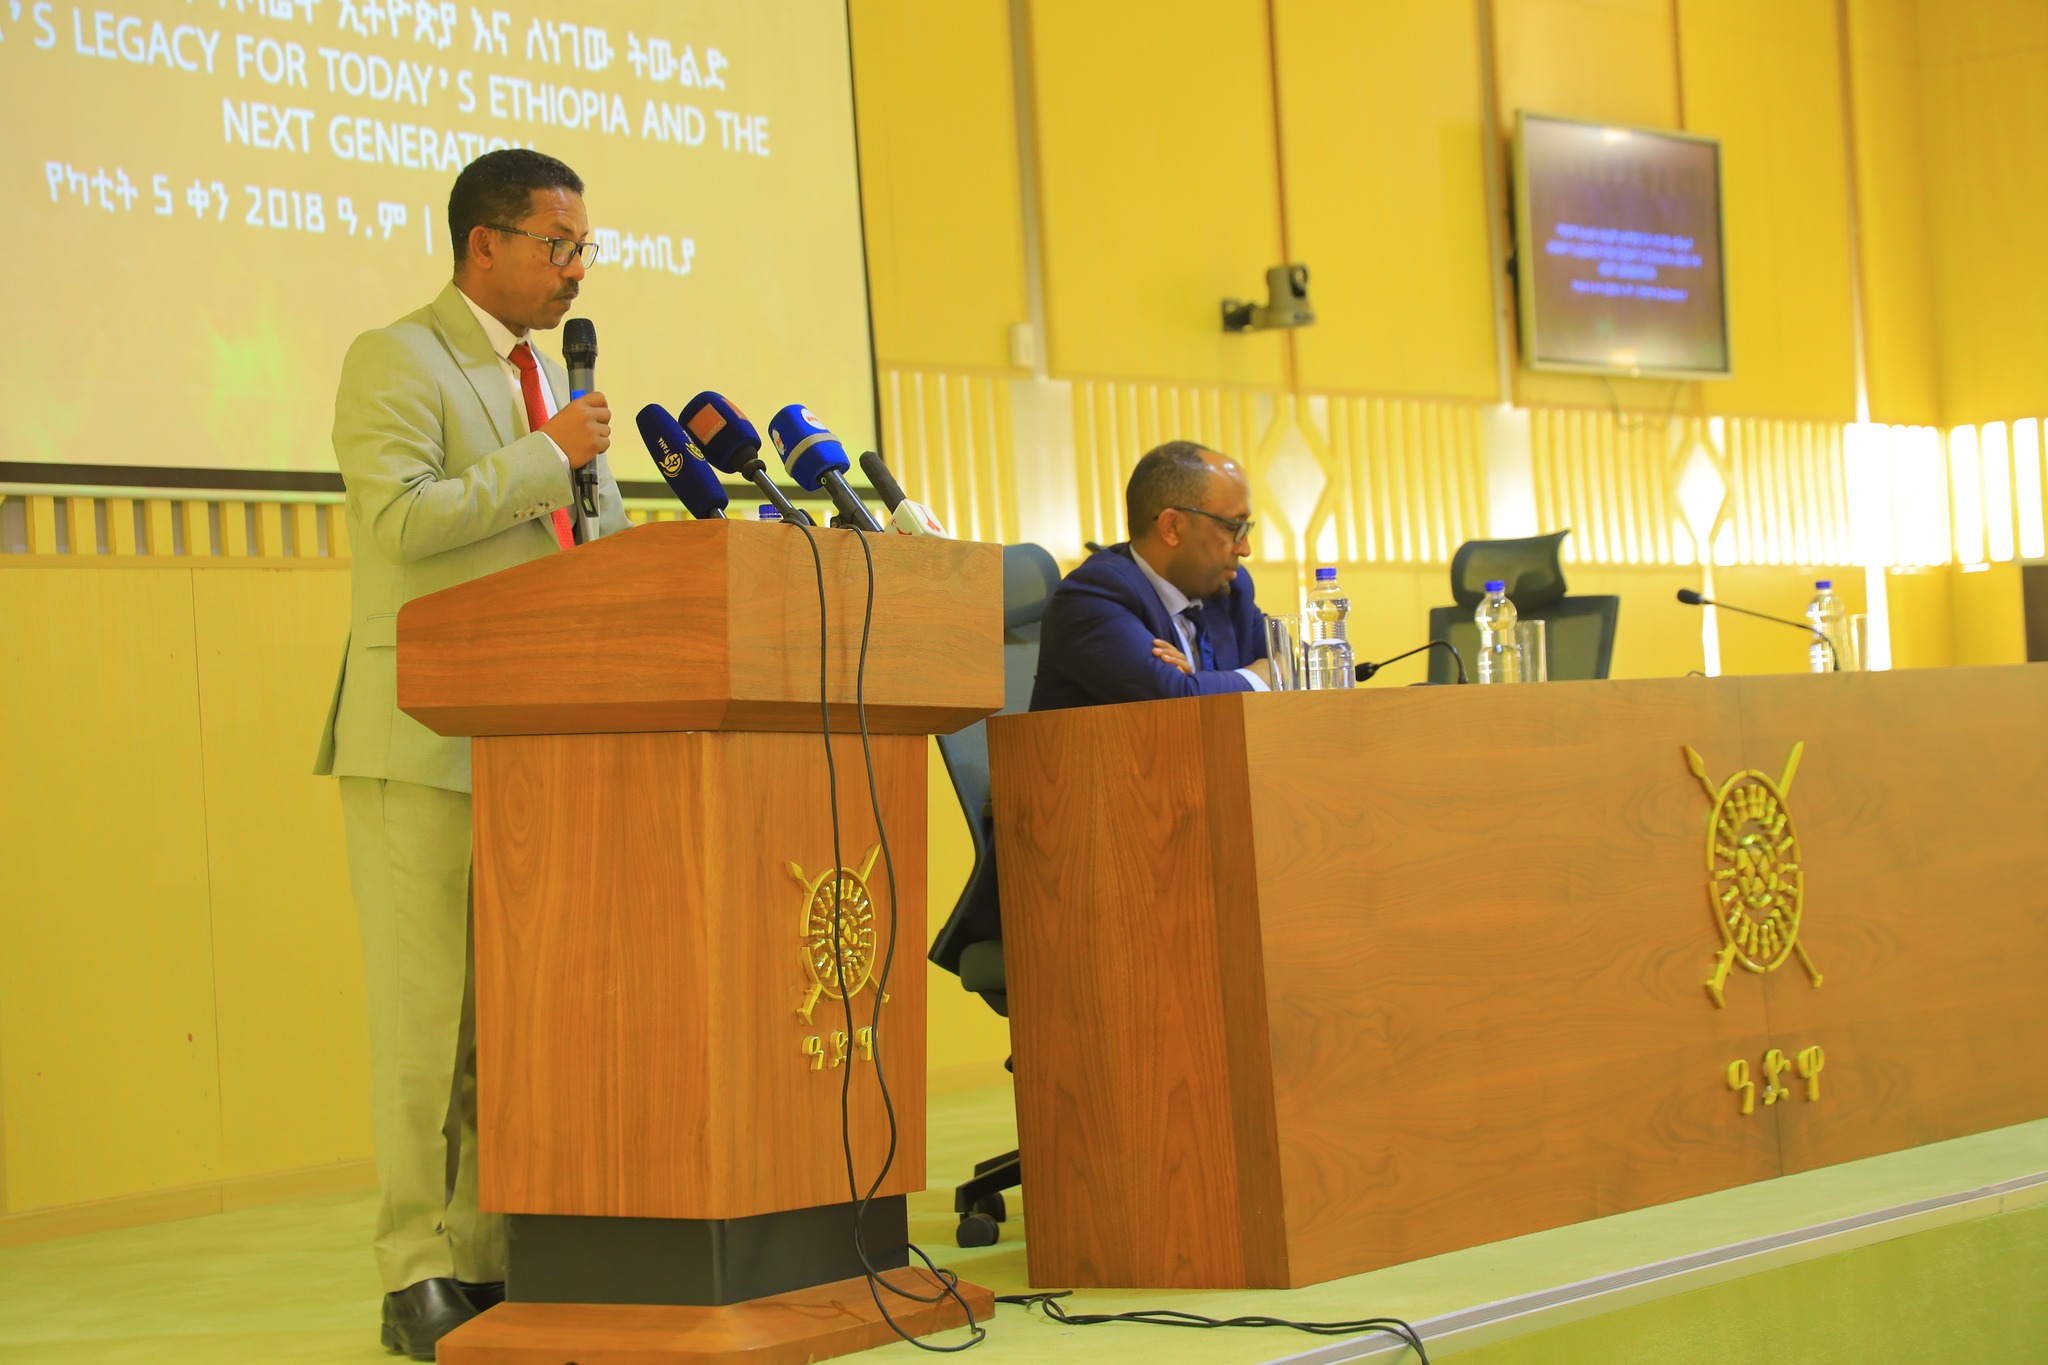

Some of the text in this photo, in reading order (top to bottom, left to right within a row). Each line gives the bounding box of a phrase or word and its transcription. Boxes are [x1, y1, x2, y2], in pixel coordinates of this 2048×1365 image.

[0, 0, 57, 49] 'S
[73, 8, 219, 74] LEGACY
[236, 34, 308, 89] FOR
[318, 47, 476, 113] TODAY'S
[489, 74, 630, 137] ETHIOPIA
[641, 99, 706, 147] AND
[715, 109, 771, 157] THE
[470, 6, 511, 57] እና
[526, 17, 614, 72] ለነገው
[627, 31, 728, 92] ትውልድ
[223, 98, 535, 172] NEXT GENERAT
[46, 160, 138, 213] የካቲት
[153, 173, 173, 216] 5
[186, 179, 229, 222] ቀን
[244, 185, 326, 233] 2018
[657, 436, 671, 455] FANA
[1727, 1044, 1825, 1115] ዓድዋ
